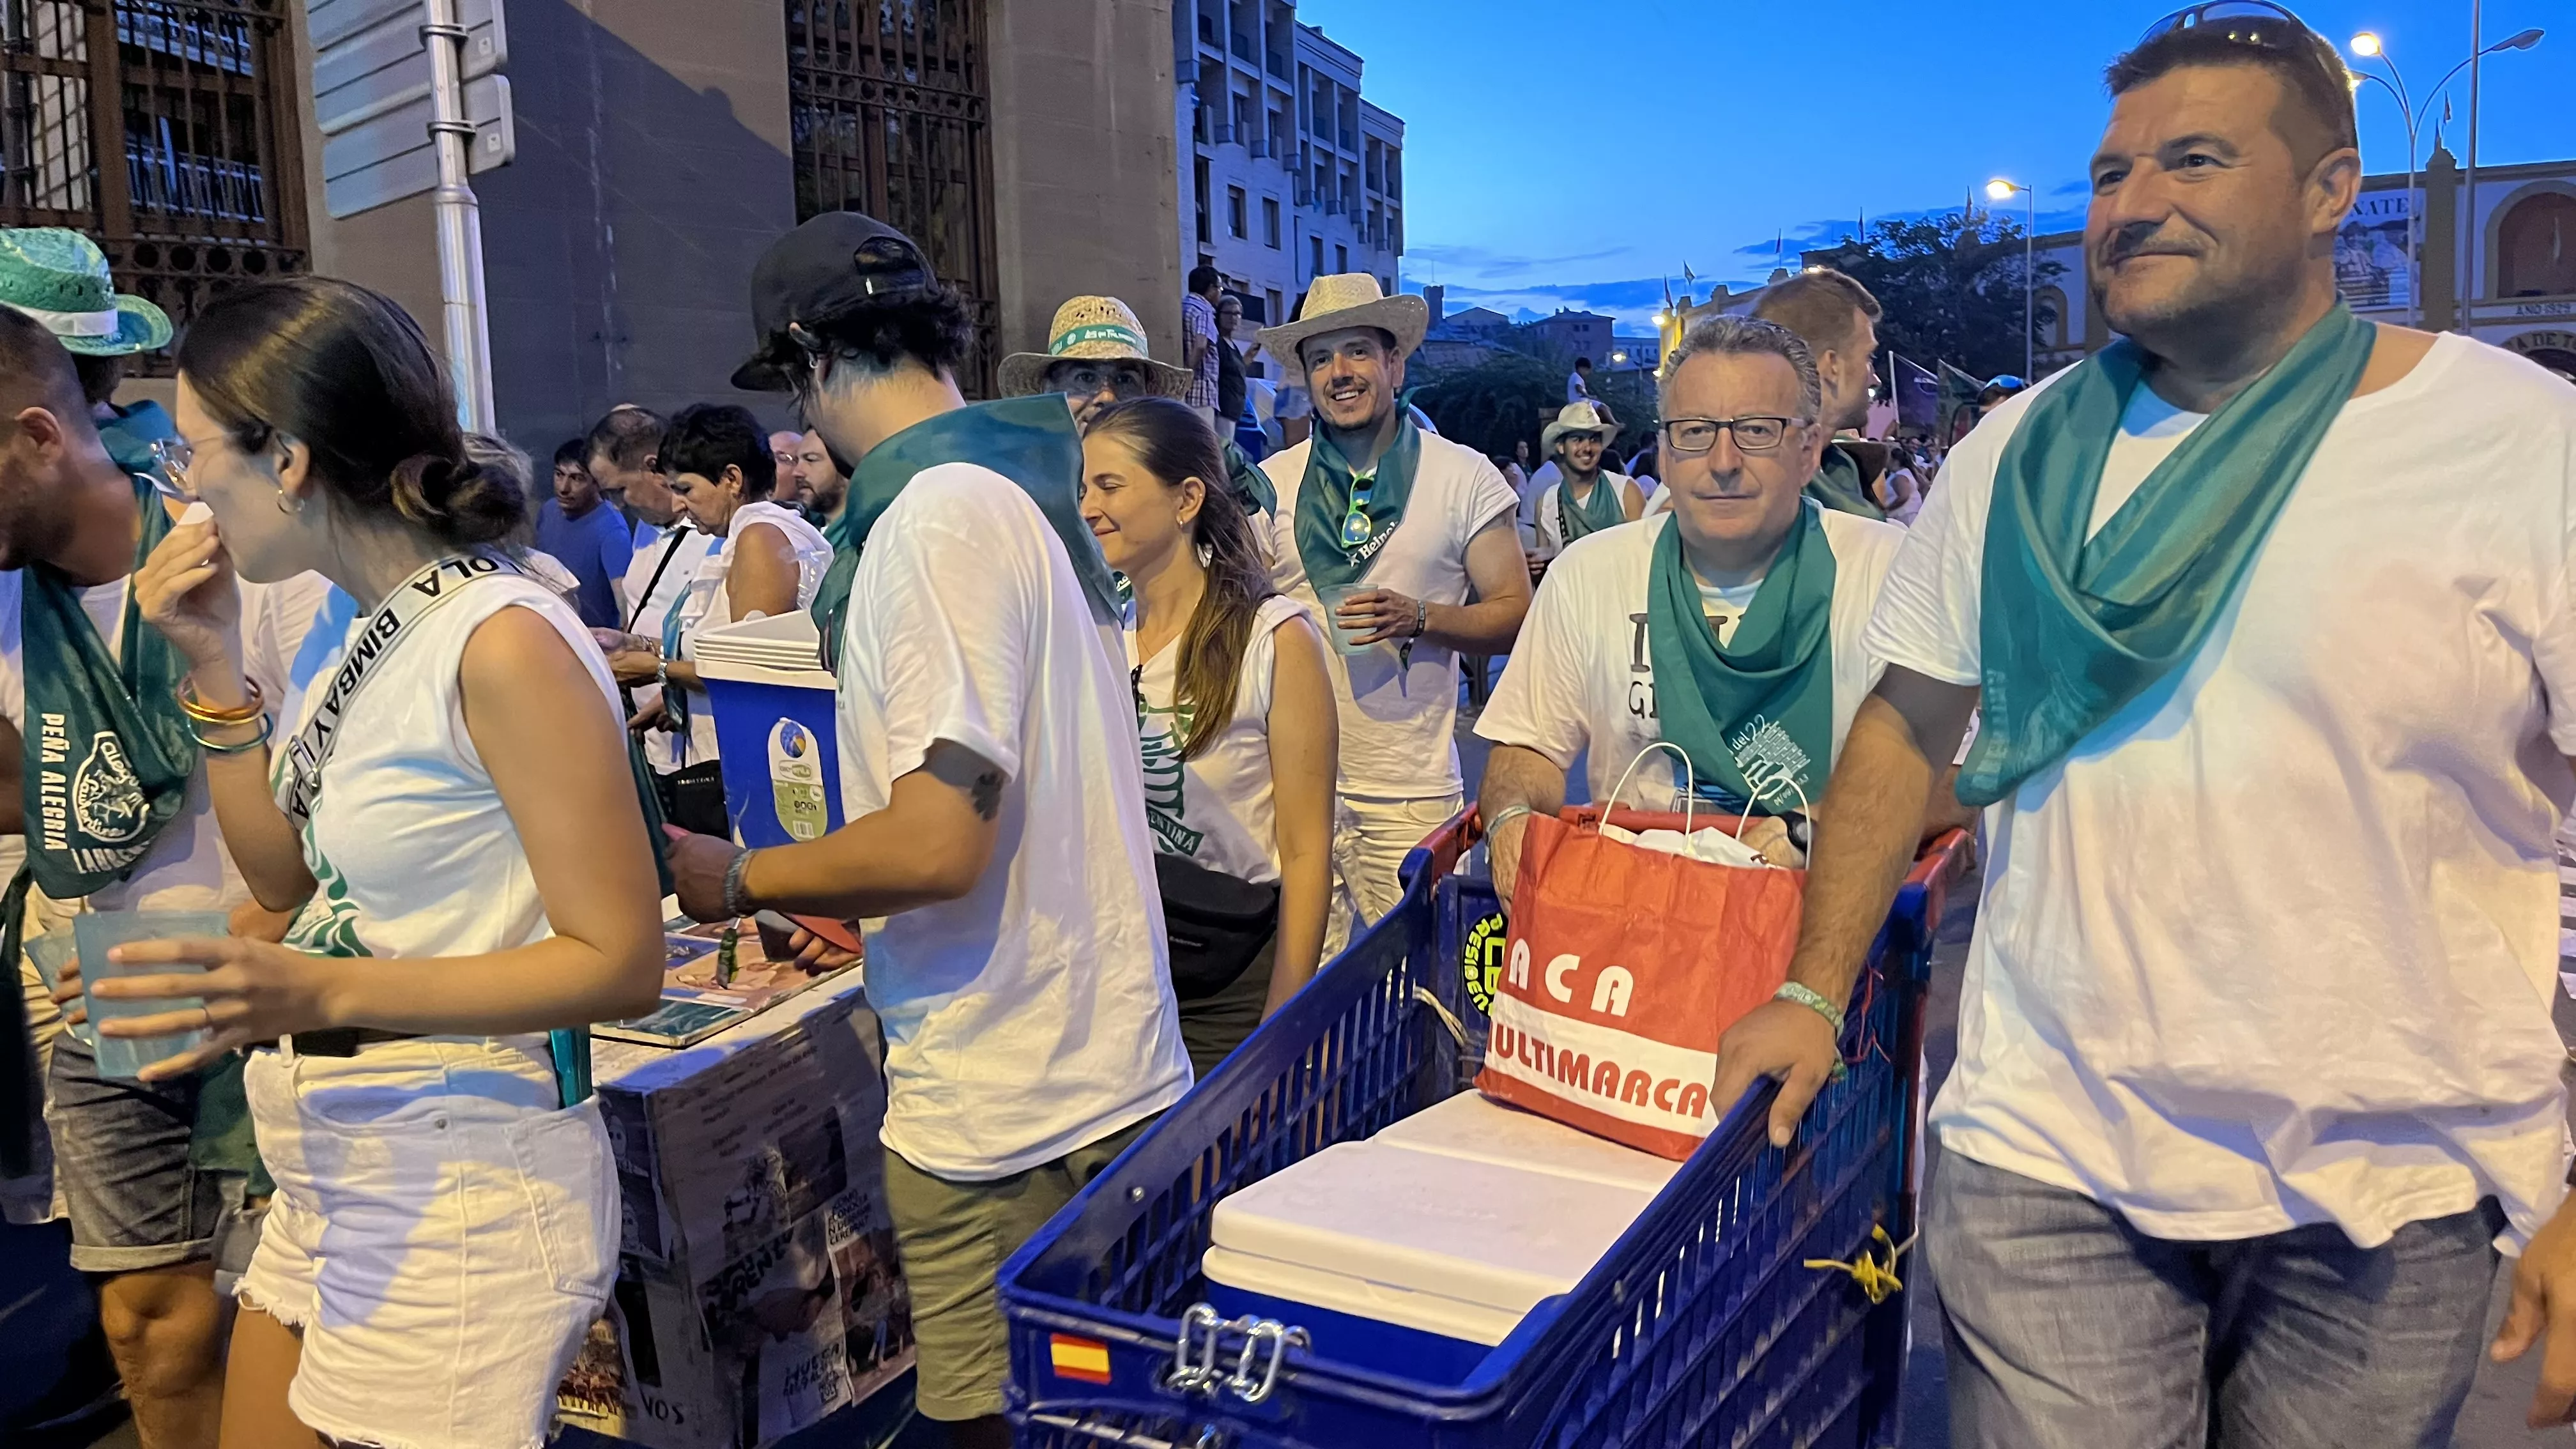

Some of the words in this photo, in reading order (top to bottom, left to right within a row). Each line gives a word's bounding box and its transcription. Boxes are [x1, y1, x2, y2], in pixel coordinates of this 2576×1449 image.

[325, 608, 401, 716] BIMBA
[41, 712, 70, 763] PEÑA
[314, 718, 332, 749] Y
[1732, 730, 1751, 751] del
[41, 770, 68, 850] ALEGRIA
